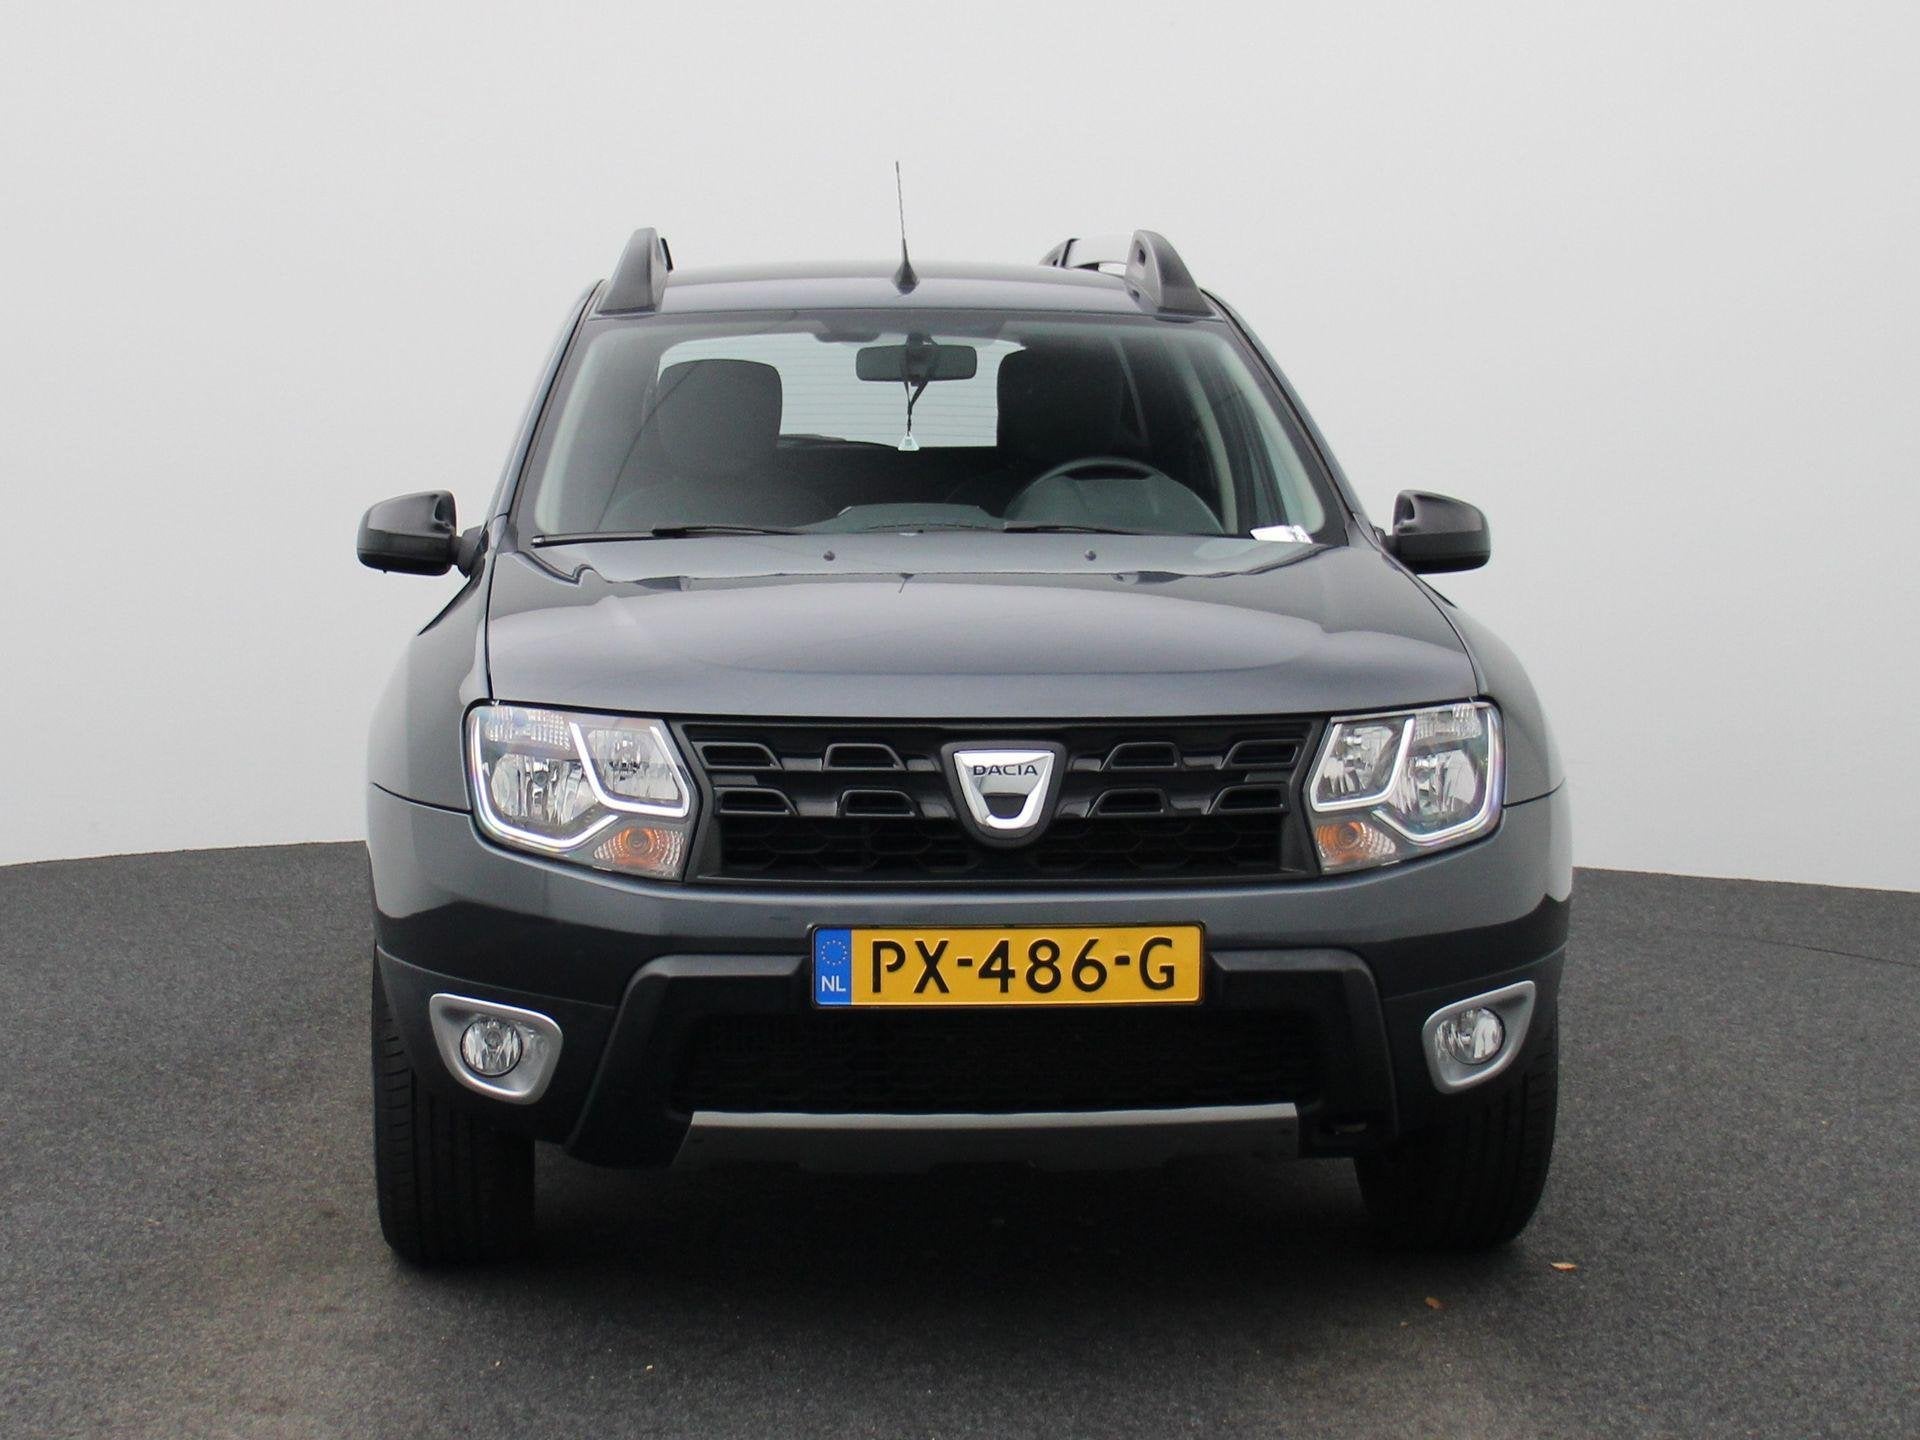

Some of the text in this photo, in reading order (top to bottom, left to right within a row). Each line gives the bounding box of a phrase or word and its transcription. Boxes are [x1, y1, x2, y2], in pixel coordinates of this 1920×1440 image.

[973, 765, 1038, 776] DACIA
[871, 937, 1175, 993] PX-486-G
[821, 976, 846, 992] NL
